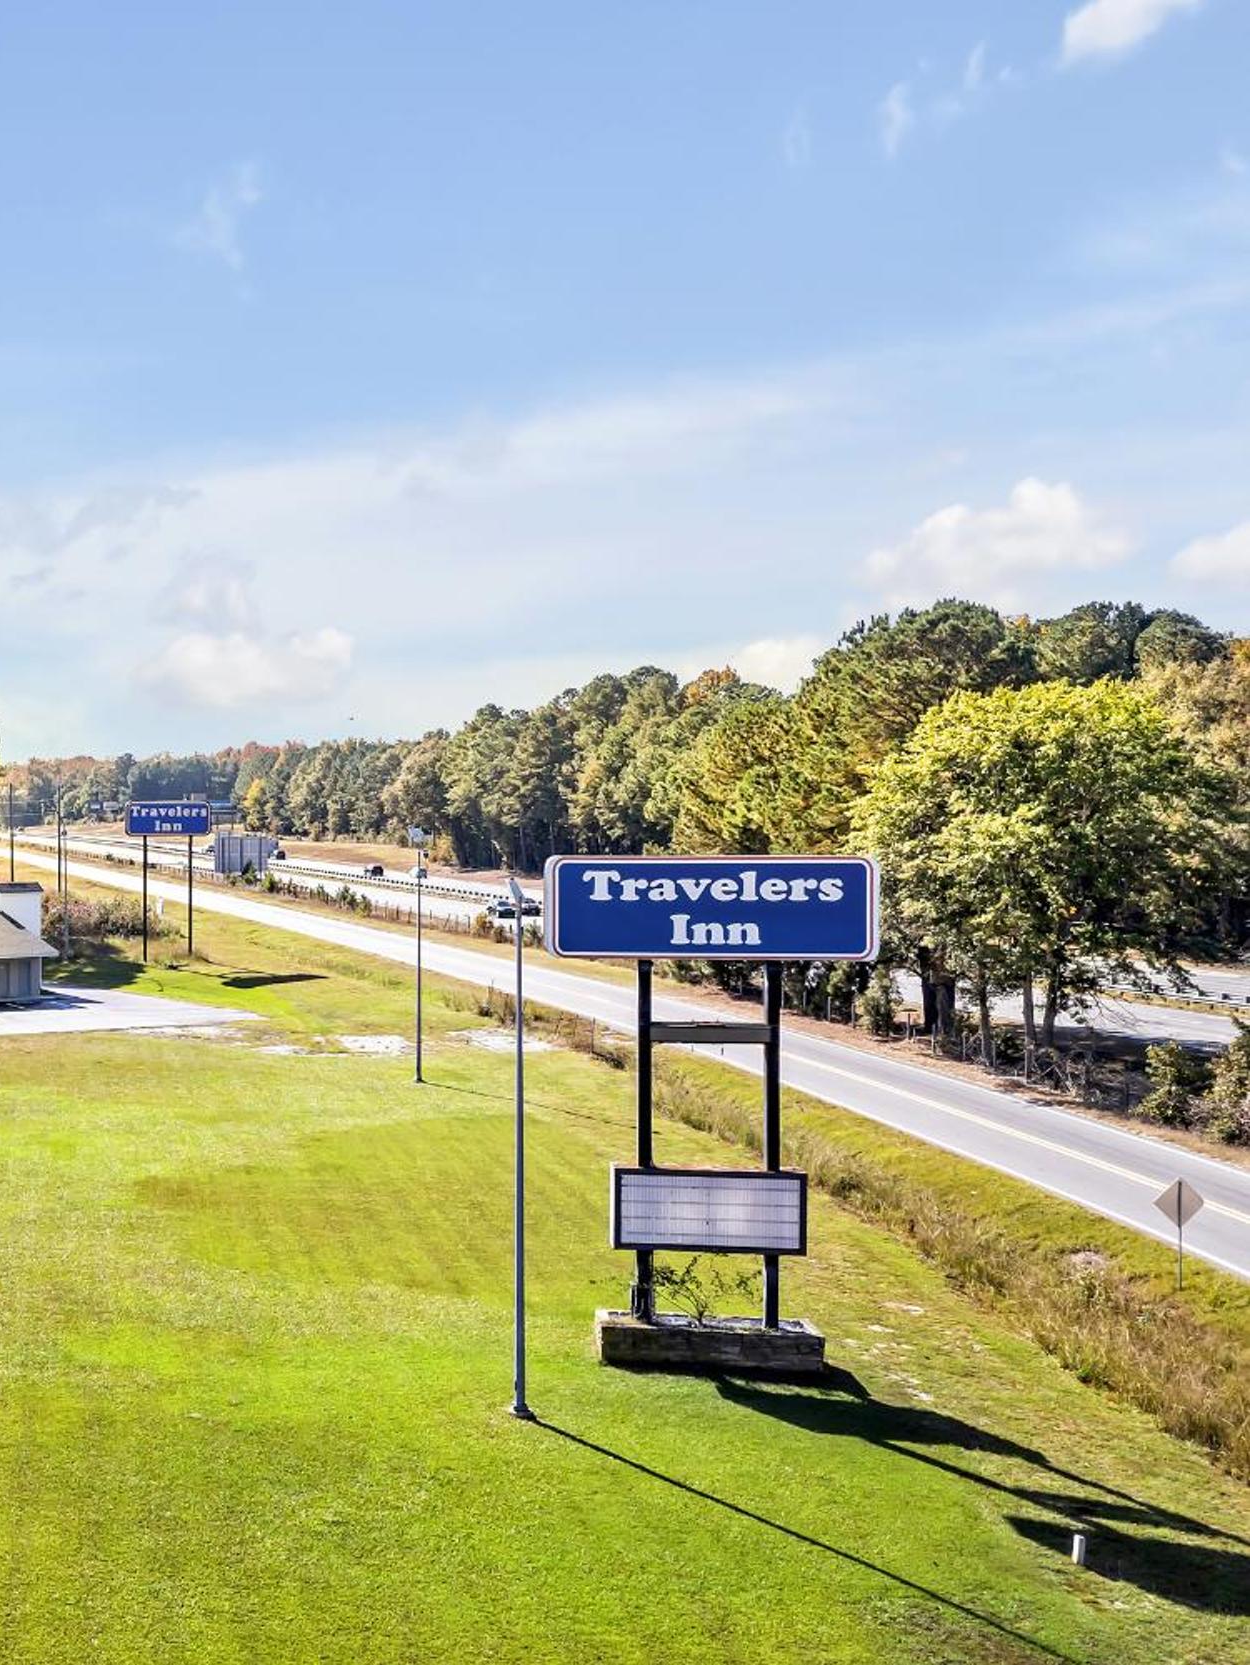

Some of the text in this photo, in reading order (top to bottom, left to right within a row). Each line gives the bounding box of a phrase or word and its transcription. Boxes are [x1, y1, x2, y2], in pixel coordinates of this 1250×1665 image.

[130, 806, 207, 817] Travelers
[154, 820, 182, 832] Inn
[582, 869, 844, 902] Travelers
[669, 914, 762, 945] Inn
